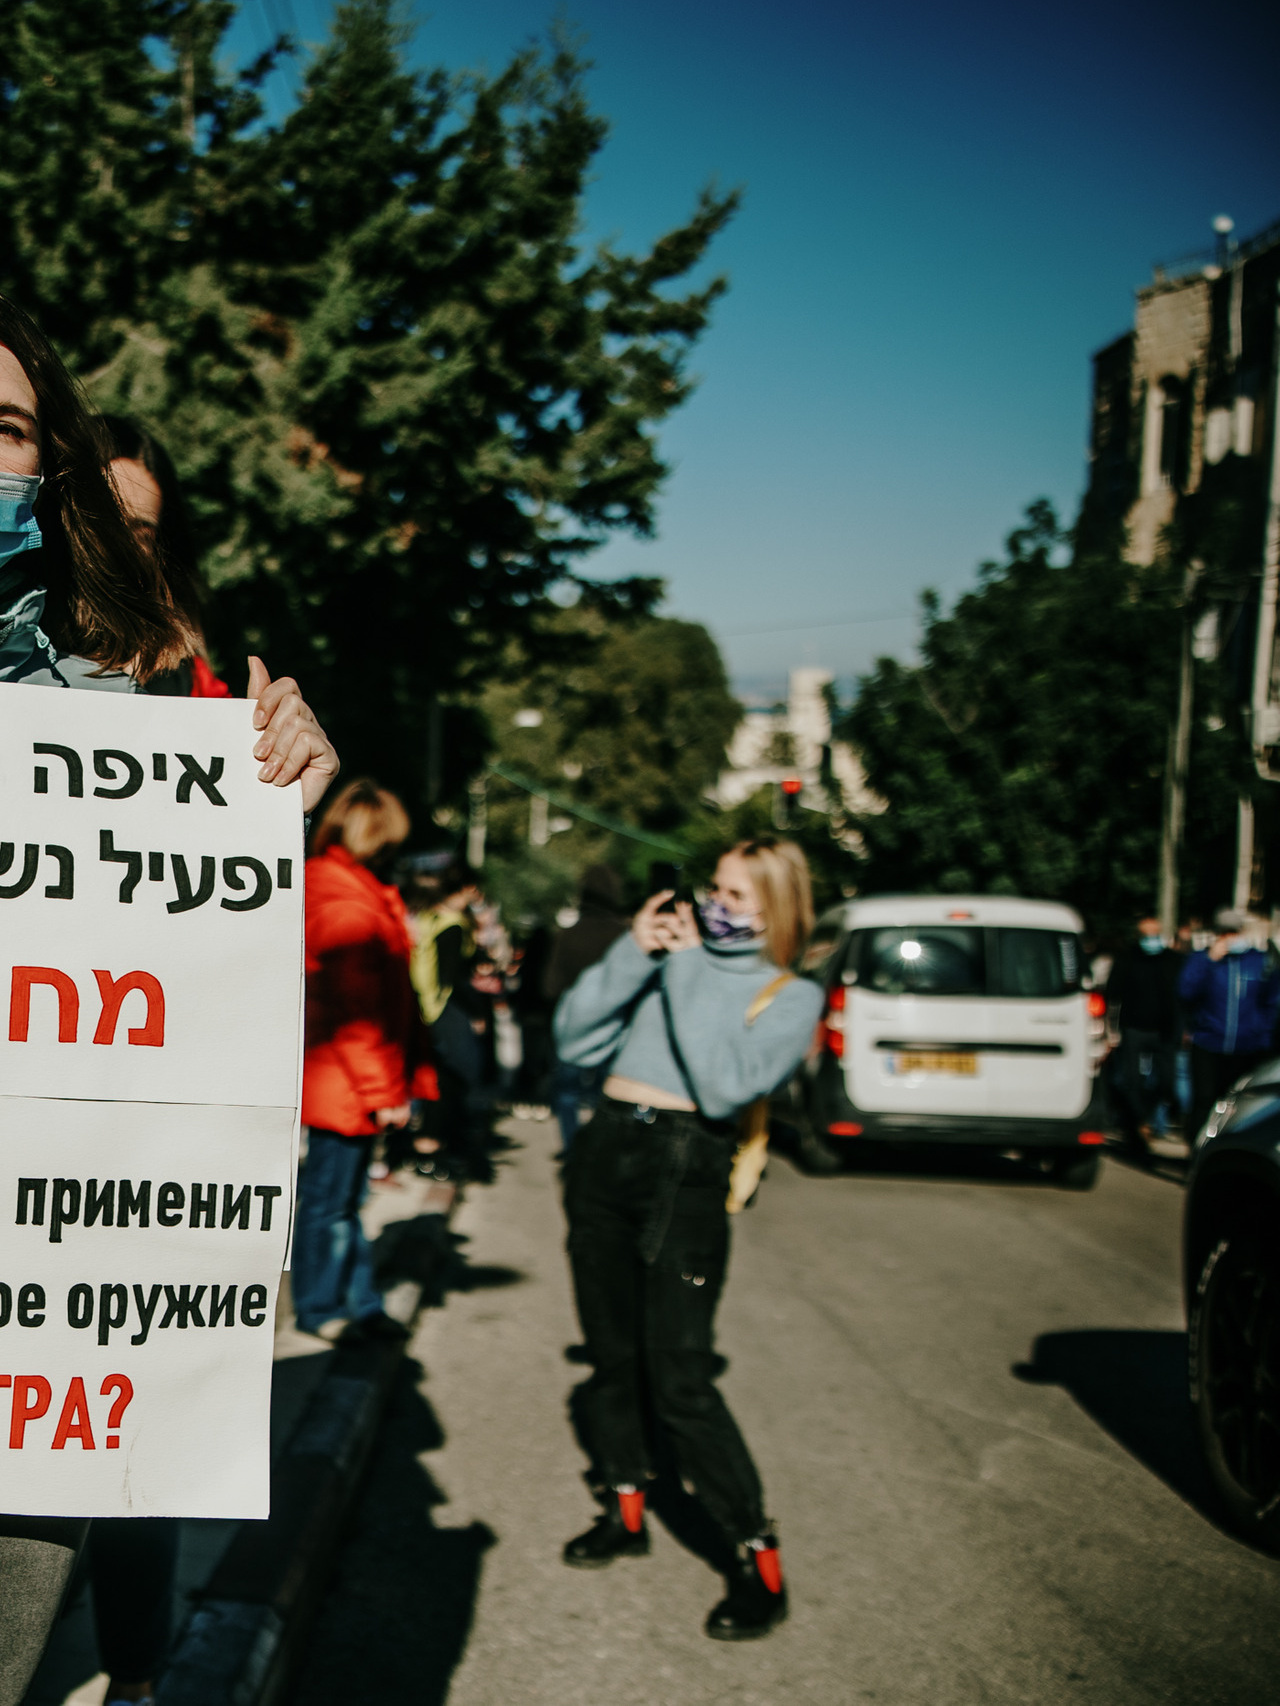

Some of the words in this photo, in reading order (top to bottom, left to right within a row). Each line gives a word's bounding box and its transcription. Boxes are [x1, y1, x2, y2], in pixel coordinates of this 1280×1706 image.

[33, 743, 227, 806] איפה
[100, 830, 292, 914] יפעיל
[15, 1178, 281, 1243] применит
[68, 1283, 267, 1346] оружие
